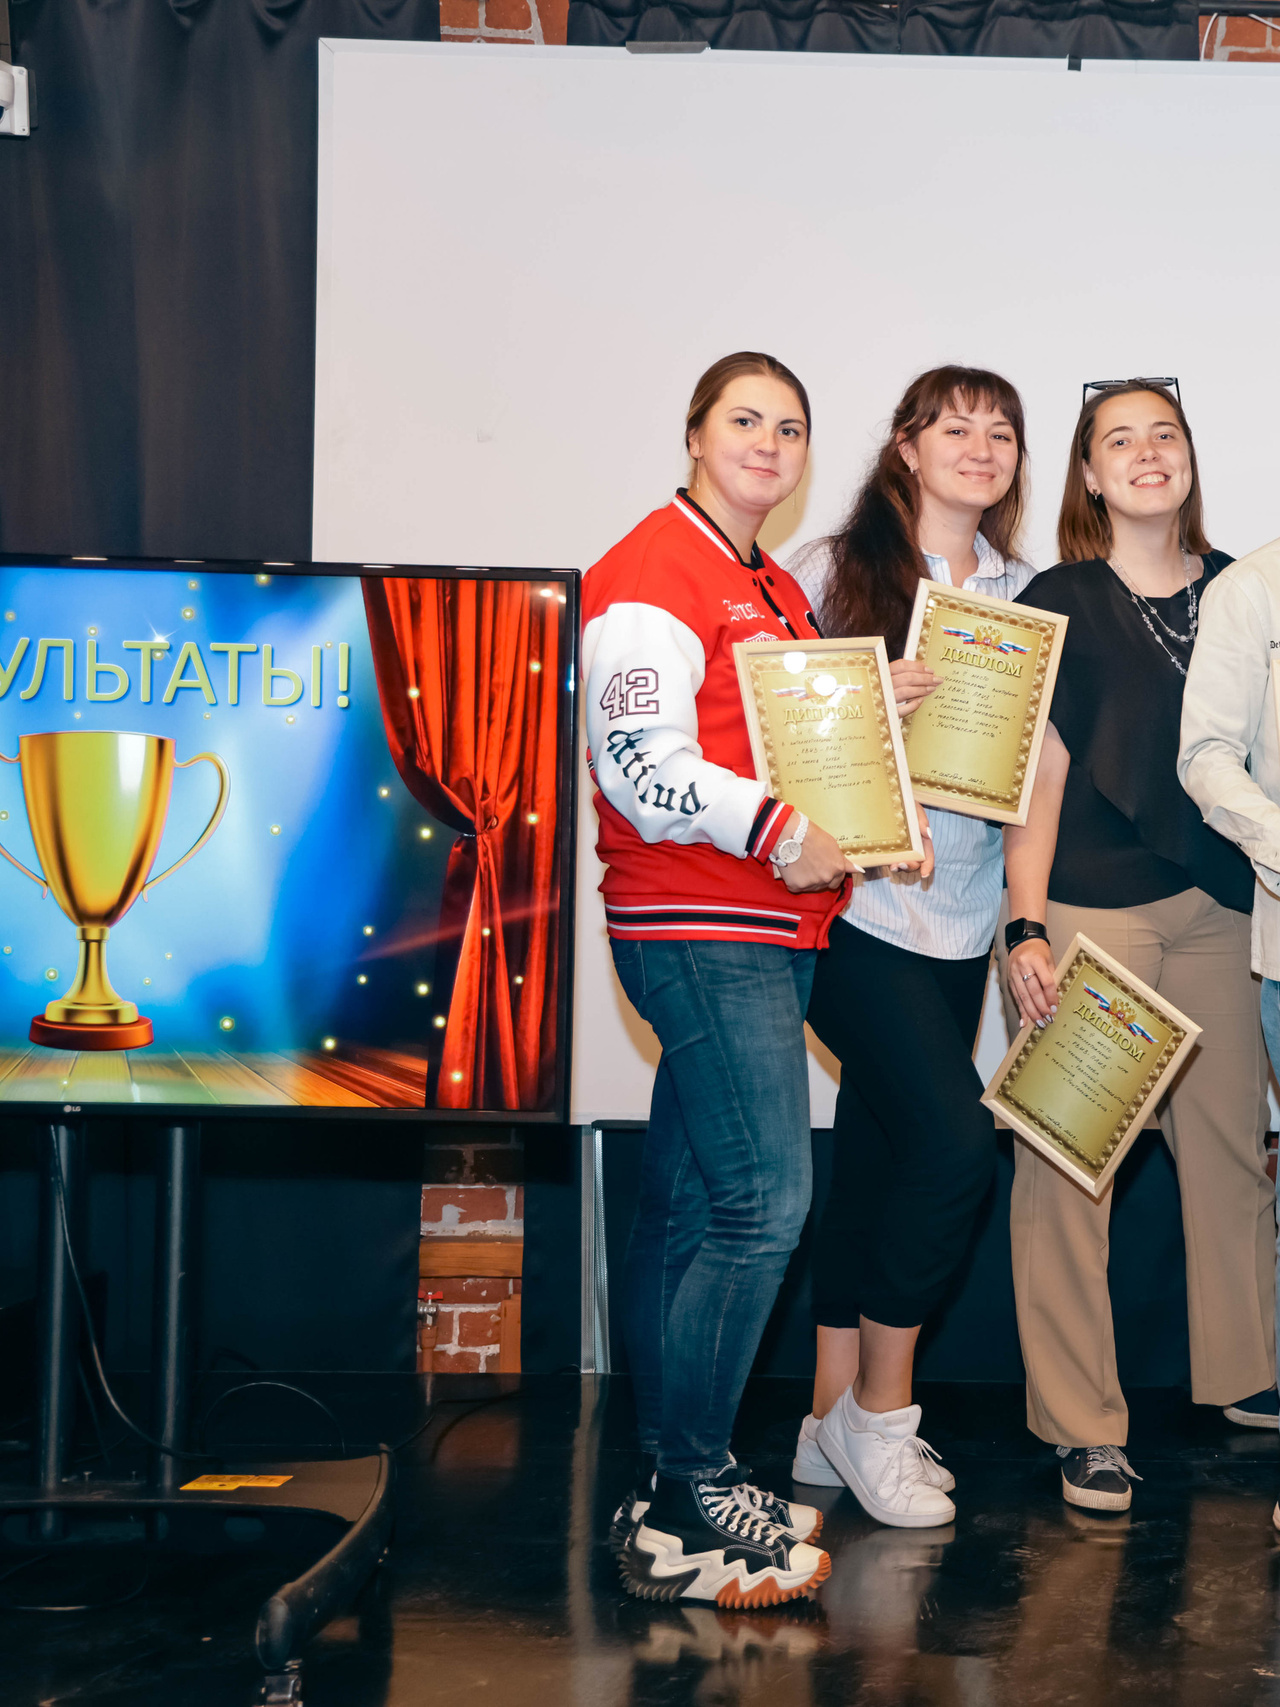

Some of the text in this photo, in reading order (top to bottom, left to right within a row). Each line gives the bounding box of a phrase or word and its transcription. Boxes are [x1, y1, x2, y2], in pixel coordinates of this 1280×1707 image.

[939, 646, 1024, 678] ДИПЛОМ
[600, 667, 660, 721] 42
[1073, 1003, 1146, 1062] ДИПЛОМ
